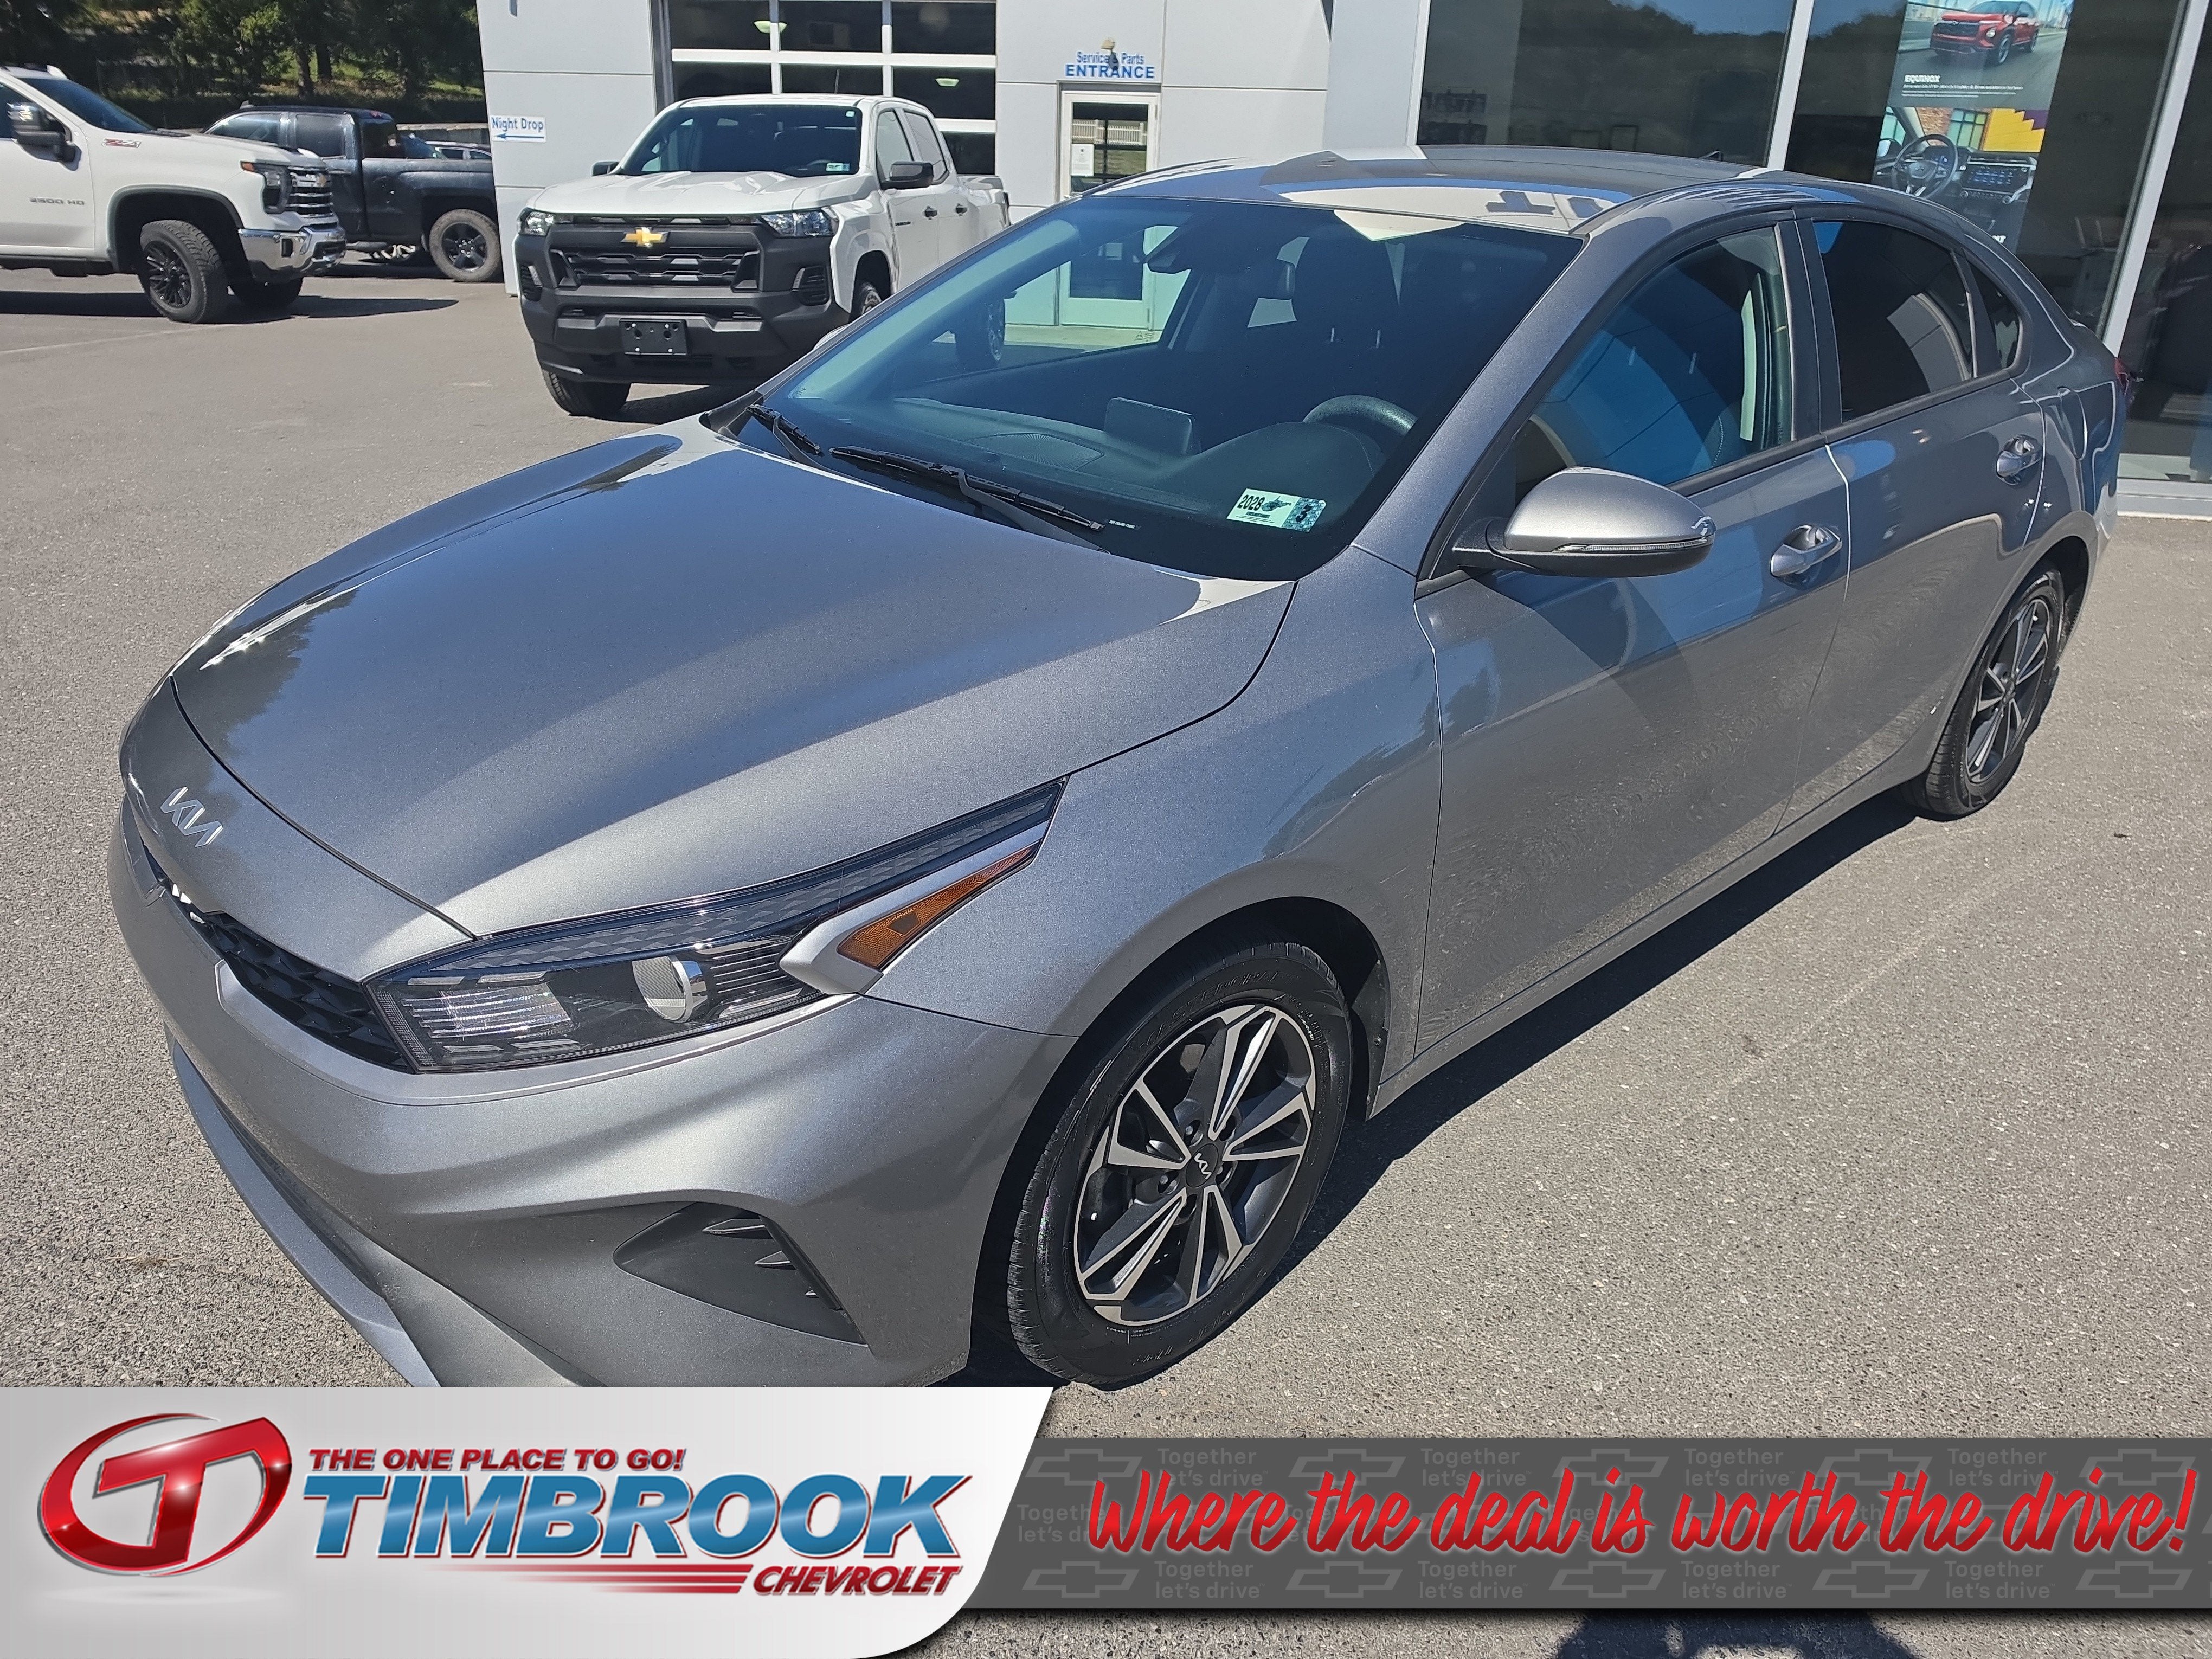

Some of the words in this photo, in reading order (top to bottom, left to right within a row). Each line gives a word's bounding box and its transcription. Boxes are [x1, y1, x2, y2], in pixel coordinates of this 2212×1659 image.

[1076, 51, 1109, 63] Service
[1121, 52, 1144, 65] Parts
[1065, 64, 1155, 79] ENTRANCE
[491, 116, 518, 132] Night
[520, 118, 543, 132] Drop
[1237, 494, 1265, 511] 2028
[1295, 505, 1313, 524] 3
